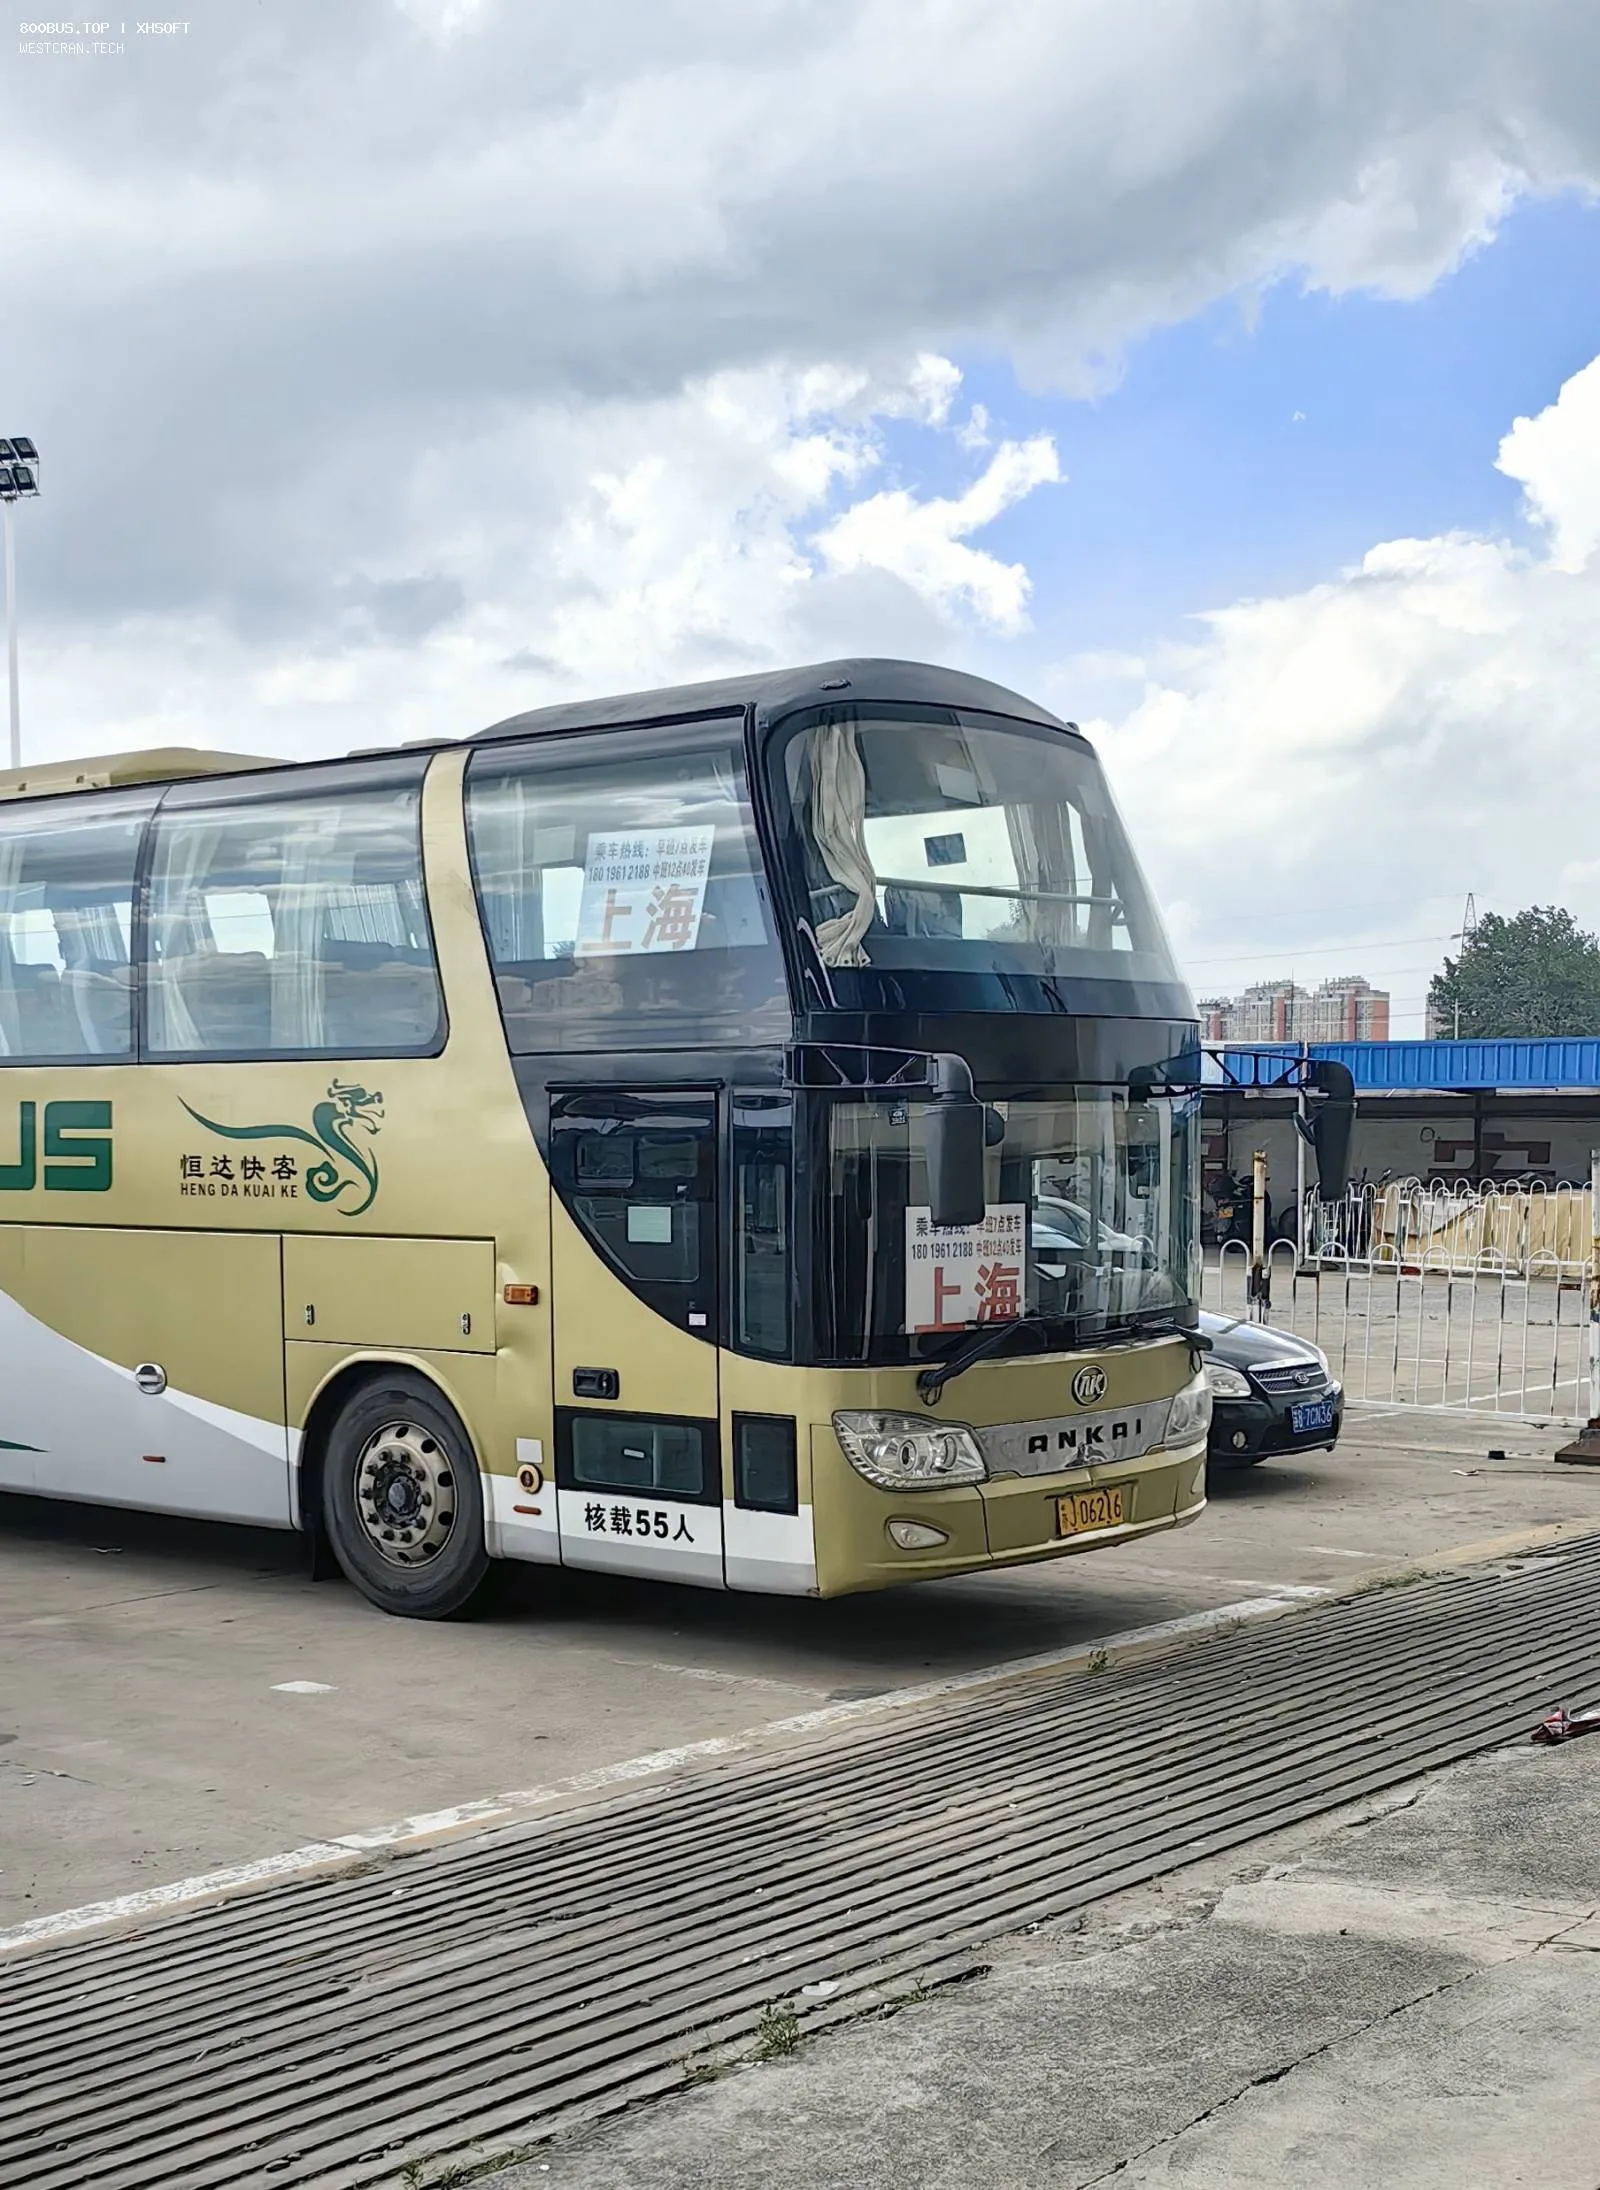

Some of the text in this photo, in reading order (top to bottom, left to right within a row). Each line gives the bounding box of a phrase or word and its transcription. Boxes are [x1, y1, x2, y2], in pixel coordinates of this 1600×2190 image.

[583, 884, 698, 951] 上海
[180, 1154, 298, 1181] 恒达快客
[180, 1182, 298, 1199] HENG DA KUAI KE
[912, 1243, 928, 1260] 180
[914, 1262, 1021, 1333] 上海
[1028, 1418, 1142, 1454] ANKAI
[584, 1502, 695, 1543] 核载55人
